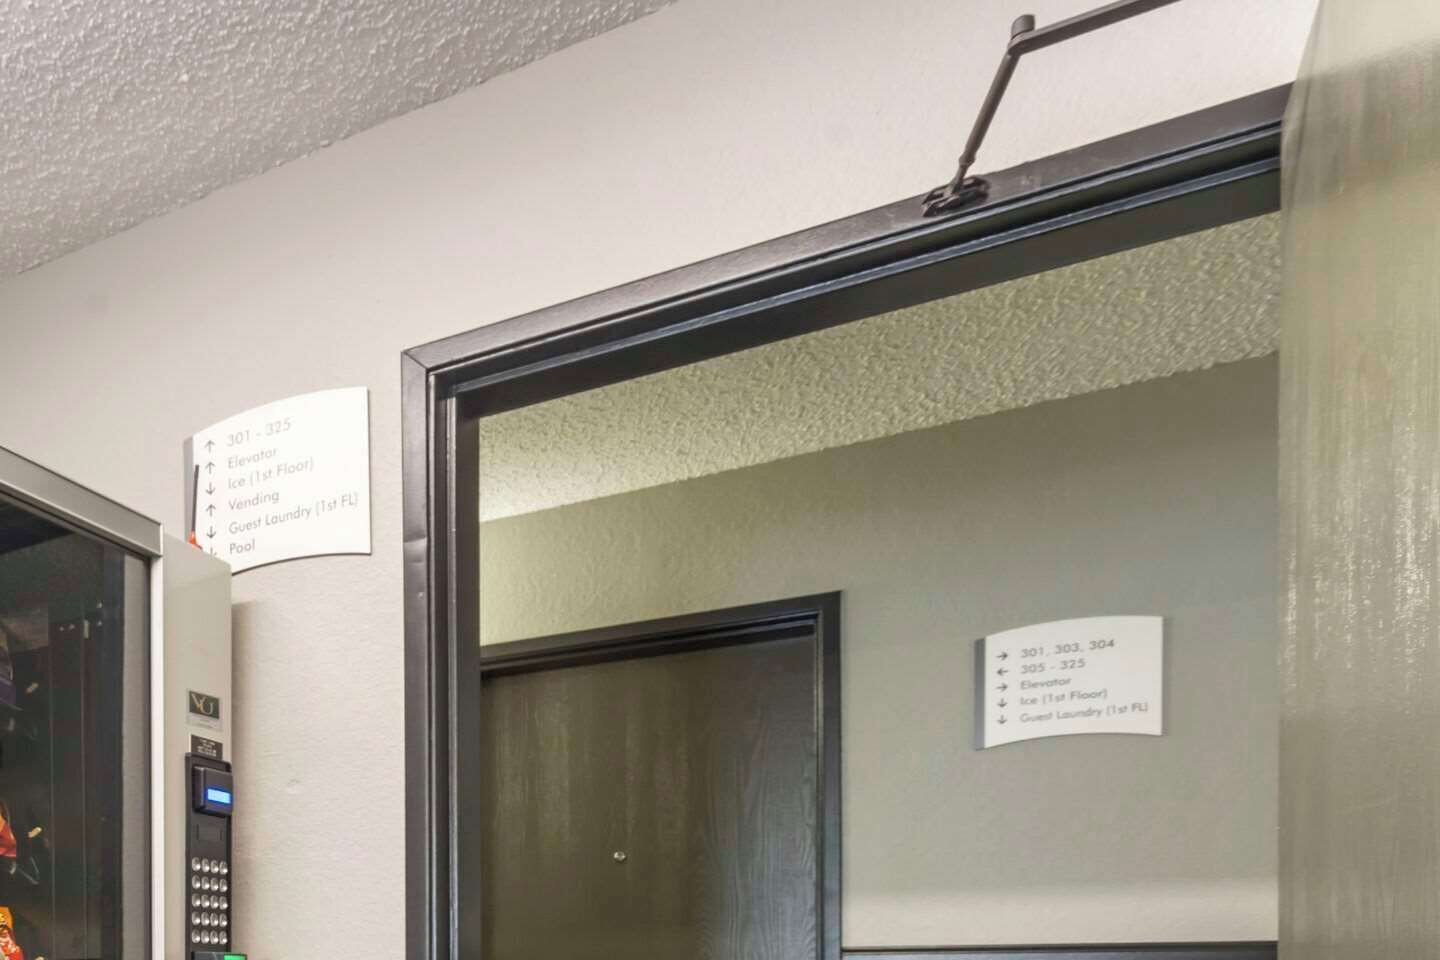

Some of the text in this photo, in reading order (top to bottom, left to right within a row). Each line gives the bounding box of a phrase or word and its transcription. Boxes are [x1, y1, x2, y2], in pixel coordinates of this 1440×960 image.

[226, 430, 251, 447] 301
[265, 417, 292, 437] 325
[227, 447, 277, 470] Elevator
[227, 457, 315, 490] Ice (1st Floor)
[227, 491, 280, 511] Vending
[228, 491, 359, 535] Guest Laundry (1st FL)
[228, 539, 256, 555] Pool
[1088, 638, 1115, 651] 304
[1020, 662, 1046, 675] 305
[1059, 658, 1086, 671] 325
[1019, 677, 1072, 690] Elevator
[1020, 689, 1108, 706] Ice (1st Floor)
[1019, 701, 1149, 724] Guest Laundry (1st FL)
